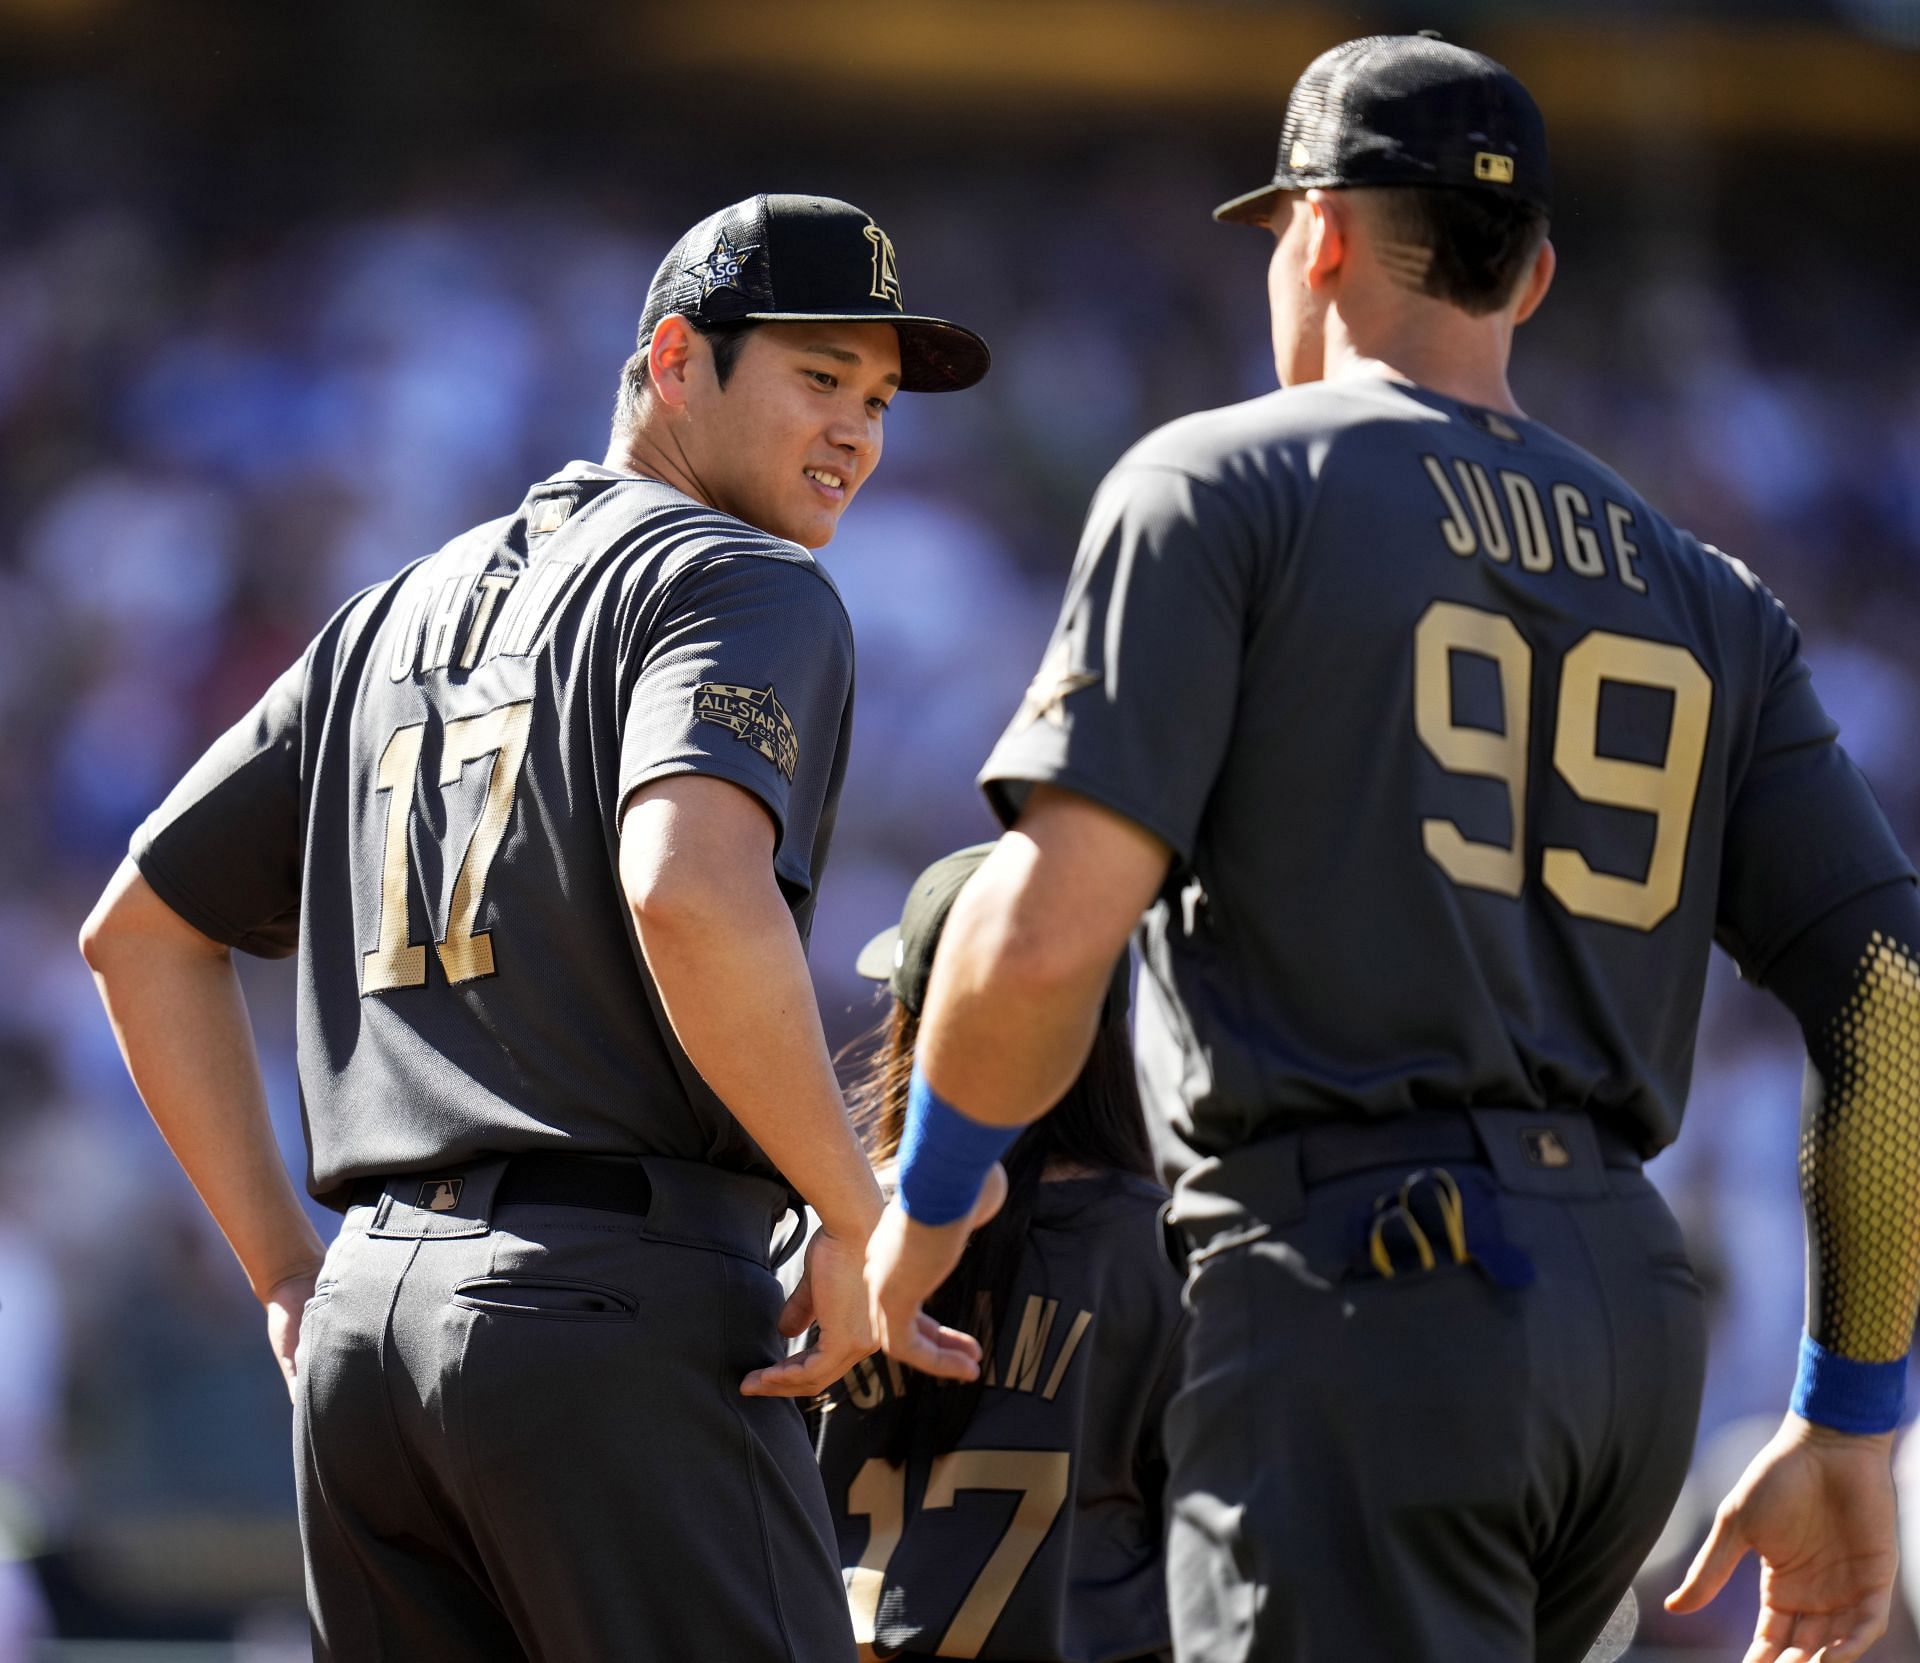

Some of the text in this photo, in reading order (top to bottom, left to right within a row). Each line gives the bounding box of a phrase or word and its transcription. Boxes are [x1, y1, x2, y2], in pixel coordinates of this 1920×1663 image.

[706, 261, 738, 279] ASG
[1423, 456, 1647, 594] JUDGE
[753, 725, 776, 744] 2022
[1414, 600, 1714, 933] 99
[360, 698, 535, 998] 17
[842, 1449, 1071, 1660] 17
